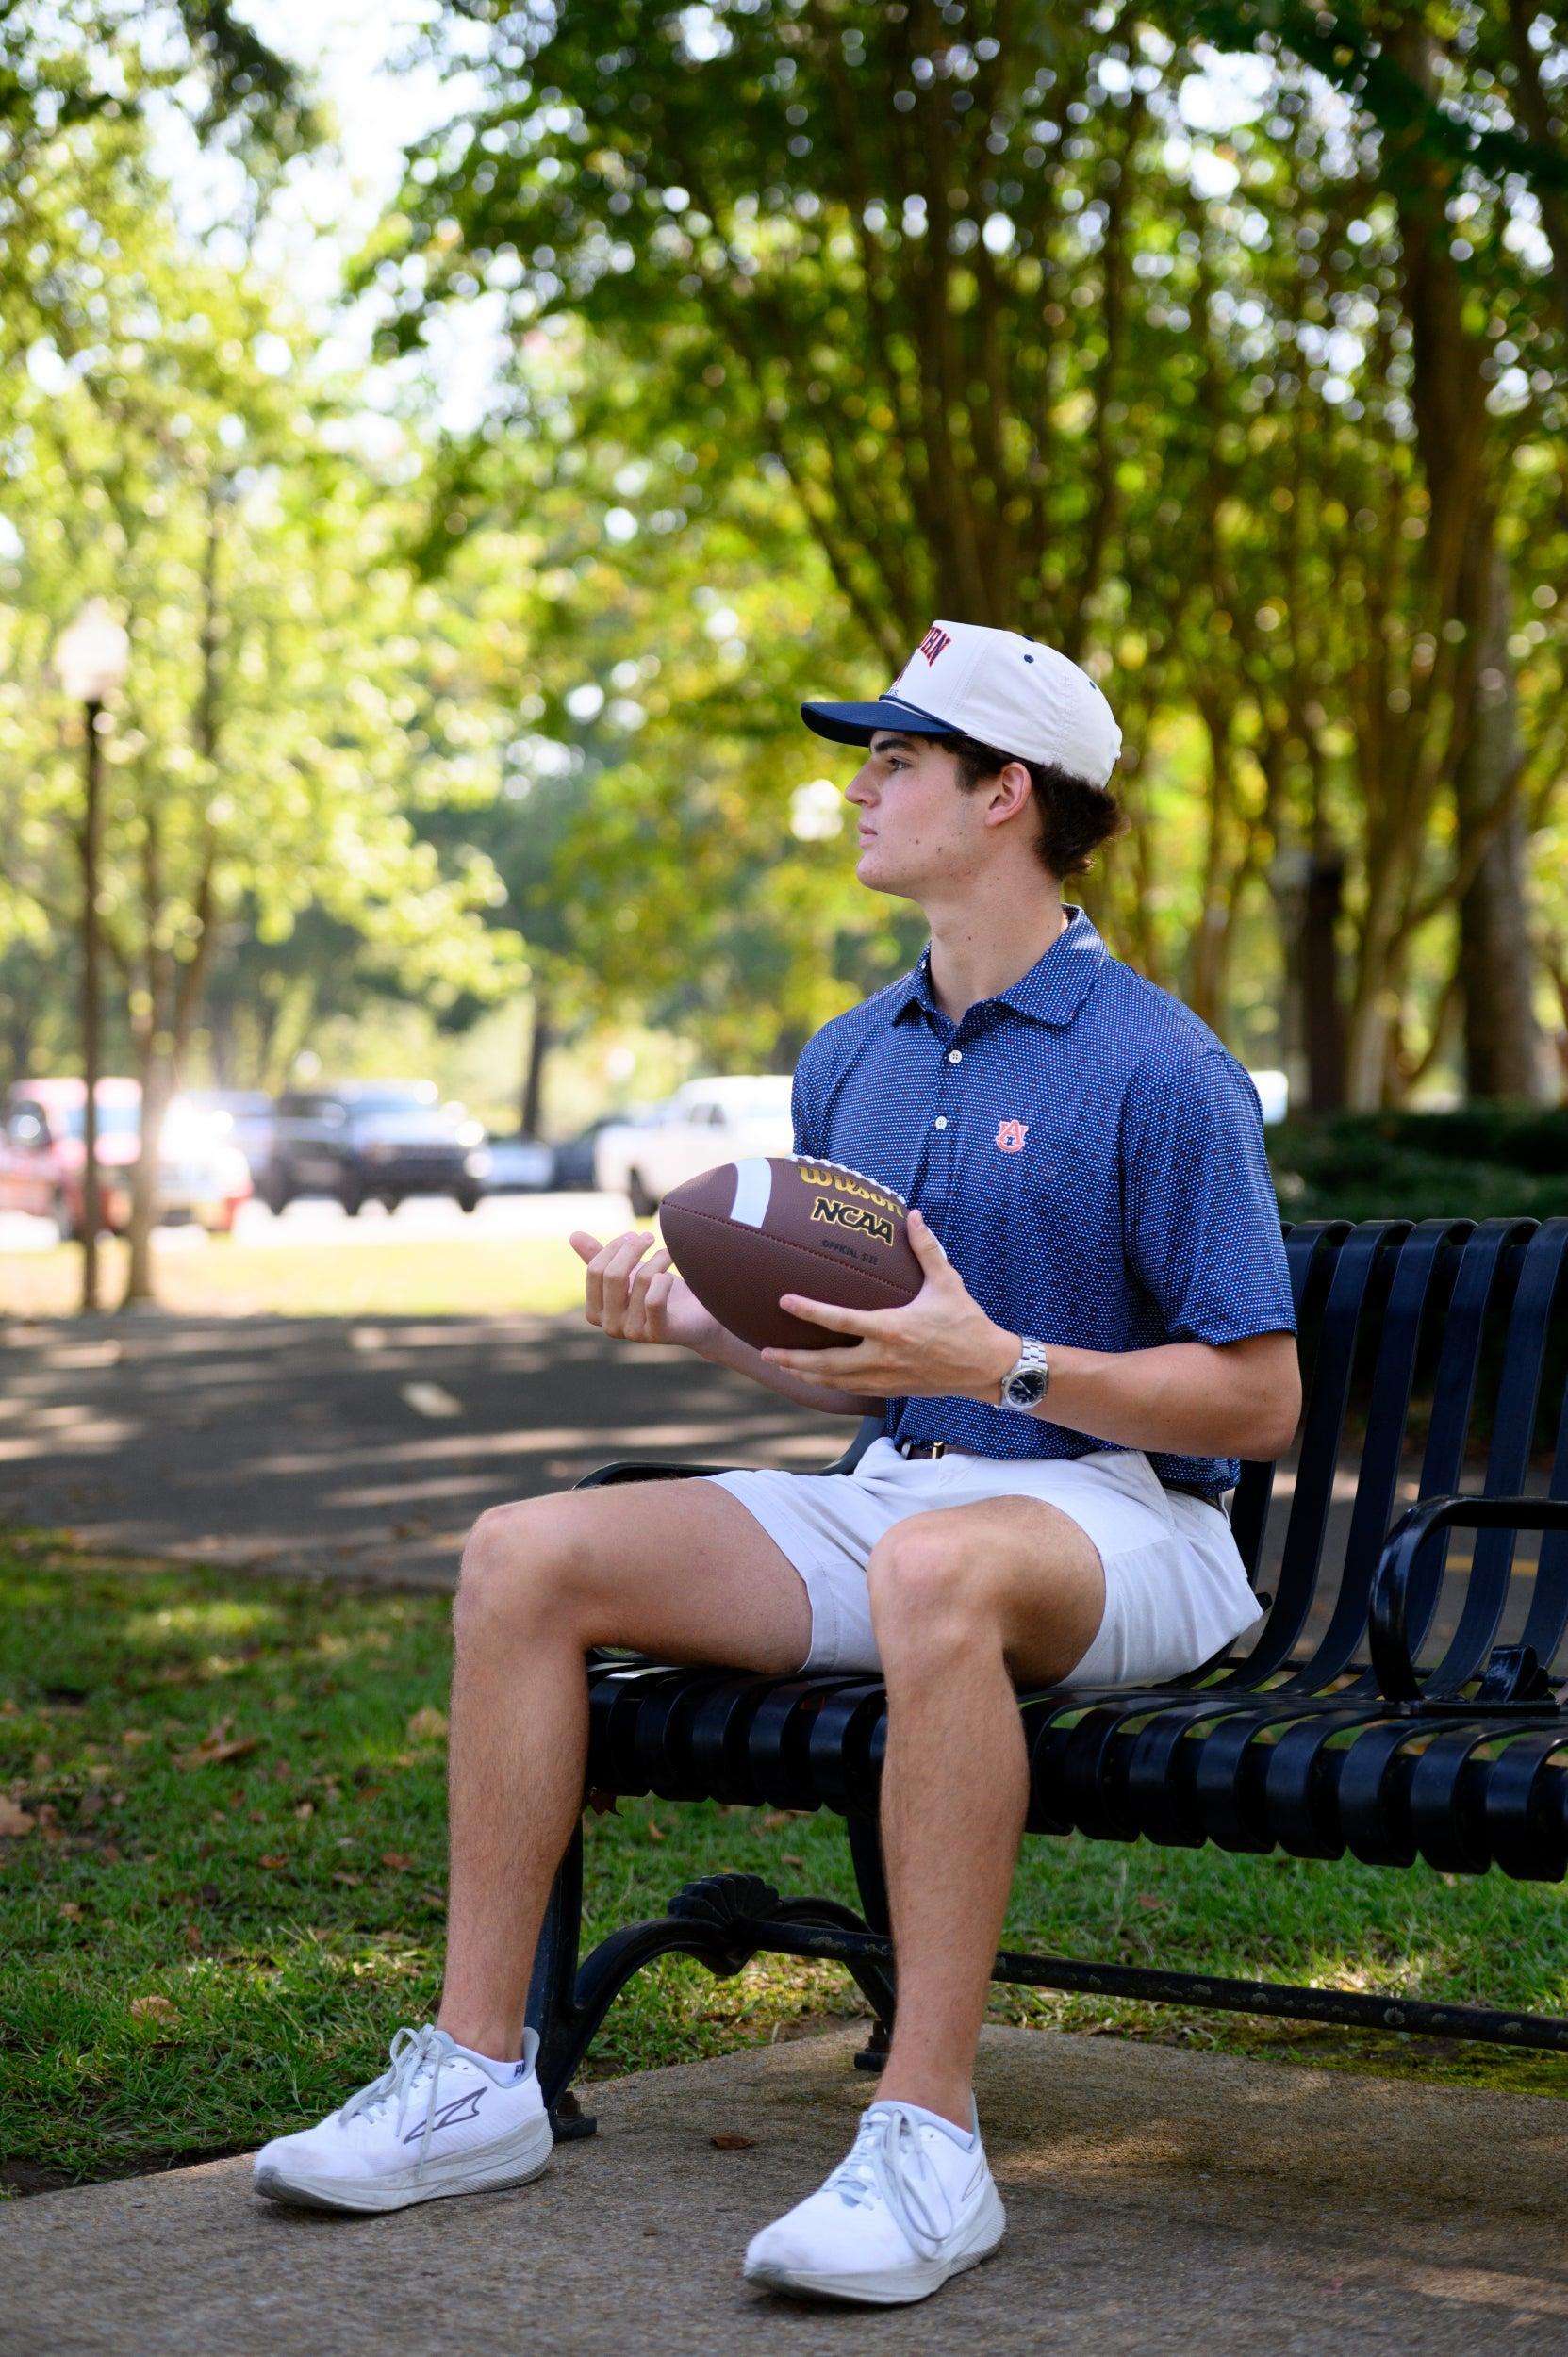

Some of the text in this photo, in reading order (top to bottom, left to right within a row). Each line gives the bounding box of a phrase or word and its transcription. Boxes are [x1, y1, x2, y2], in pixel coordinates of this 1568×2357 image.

[799, 1165, 906, 1221] Wilson
[810, 1196, 895, 1247] NCAA
[821, 1239, 880, 1266] OFFICIAL SIZE
